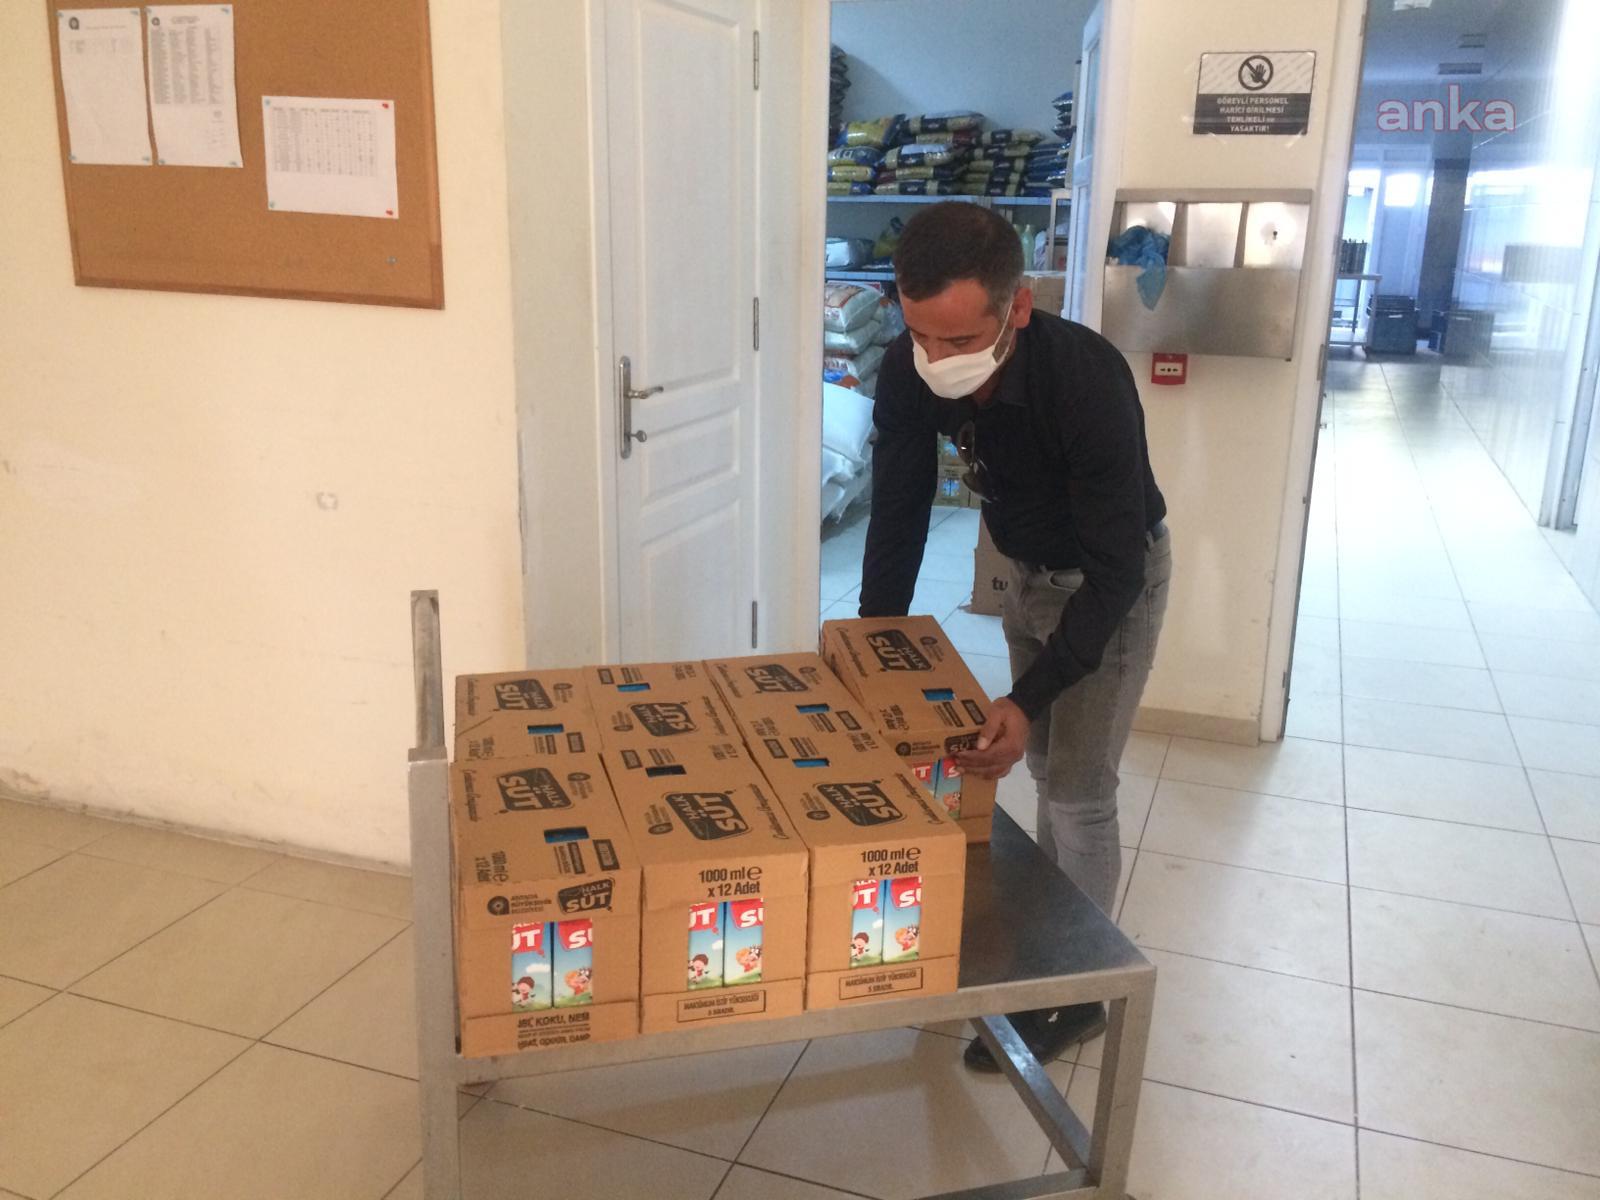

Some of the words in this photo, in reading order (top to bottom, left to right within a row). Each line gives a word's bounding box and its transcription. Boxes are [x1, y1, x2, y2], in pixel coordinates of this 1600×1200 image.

[1216, 95, 1249, 105] GÖREVLİ
[1250, 97, 1289, 105] PERSONEL
[868, 636, 911, 670] SÜT
[653, 704, 697, 730] SÜT
[499, 775, 543, 808] SÜT
[843, 784, 901, 818] SÜT
[671, 795, 701, 820] HALK
[693, 794, 746, 831] SÜT
[861, 849, 888, 863] 1000
[699, 868, 728, 883] 1000
[868, 866, 875, 876] x
[878, 863, 891, 875] 12
[893, 861, 919, 874] Adet
[582, 882, 610, 894] HALK
[708, 887, 715, 897] x
[718, 883, 732, 896] 12
[734, 881, 761, 895] Adet
[566, 892, 609, 912] SÜT
